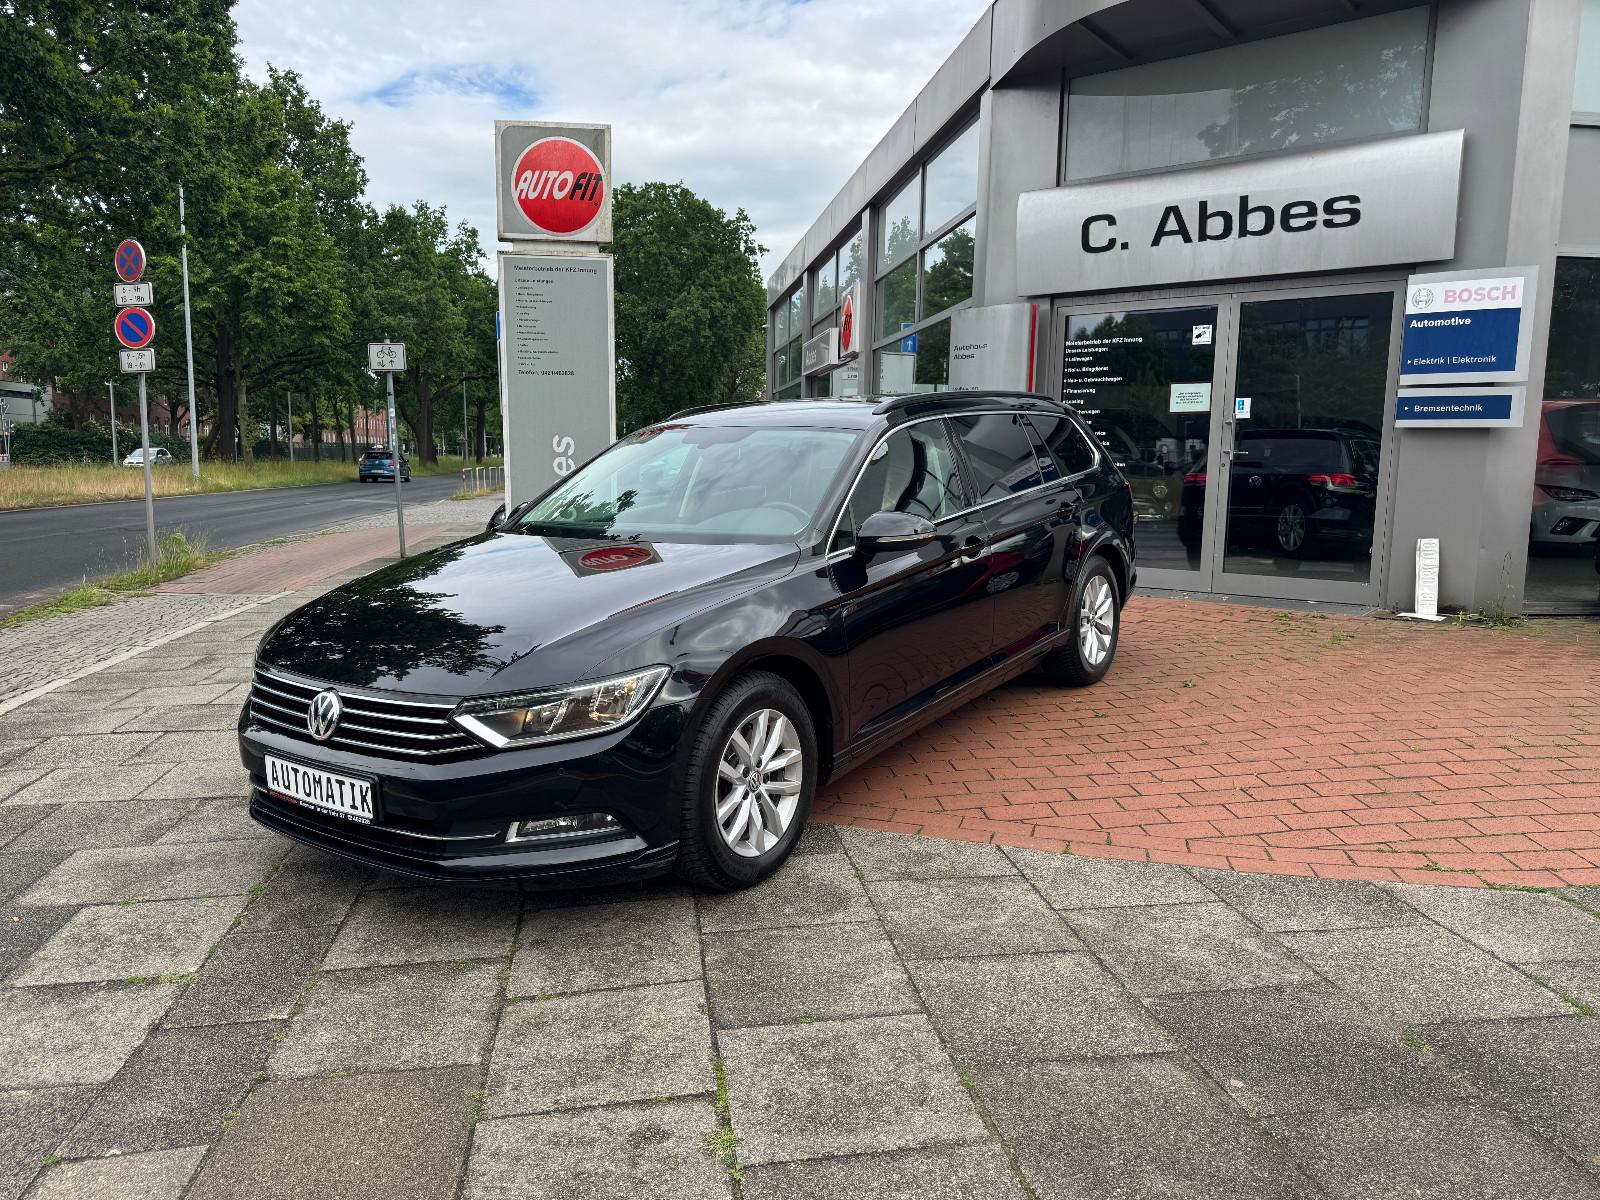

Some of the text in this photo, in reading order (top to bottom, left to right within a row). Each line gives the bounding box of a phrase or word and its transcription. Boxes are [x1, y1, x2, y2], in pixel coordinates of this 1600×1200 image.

[516, 170, 603, 202] AUTOFIT
[1081, 194, 1361, 254] C. Abbes
[1444, 285, 1517, 304] BOSCH
[1410, 316, 1472, 328] Automotive
[954, 344, 988, 352] Autohaus
[1414, 357, 1444, 366] Elektrik
[1452, 355, 1497, 364] Elektronik
[1414, 403, 1483, 412] Bremsentechnik
[552, 434, 576, 476] es
[272, 760, 372, 814] AUTOMATIK
